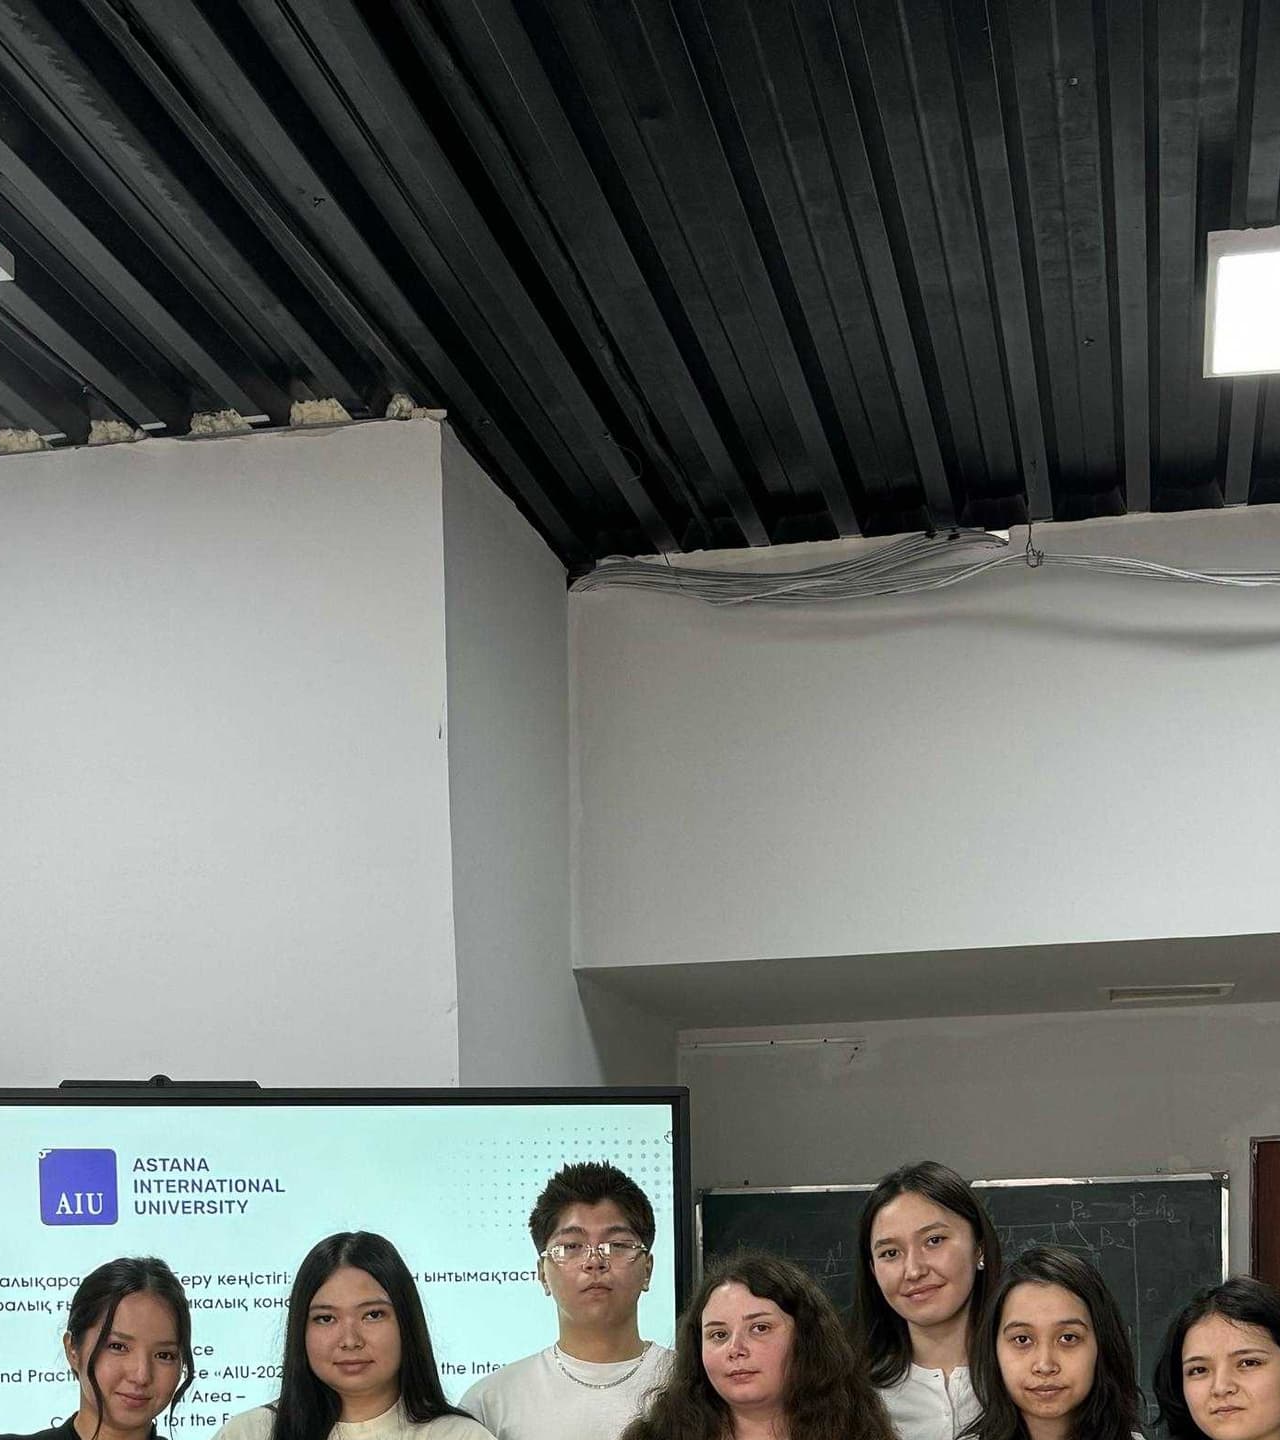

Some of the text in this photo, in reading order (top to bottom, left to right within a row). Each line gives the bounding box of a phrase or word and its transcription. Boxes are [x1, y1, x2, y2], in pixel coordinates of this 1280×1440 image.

[132, 1157, 210, 1173] ASTANA
[133, 1178, 286, 1194] INTERNATIONAL
[55, 1192, 104, 1215] AIU
[134, 1199, 249, 1215] UNIVERSITY
[218, 1271, 292, 1289] кеңістігі:
[424, 1271, 537, 1285] ынтымақтаст
[214, 1365, 284, 1380] «AIU-202
[441, 1361, 467, 1375] the
[192, 1390, 232, 1404] Area
[191, 1413, 217, 1427] the
